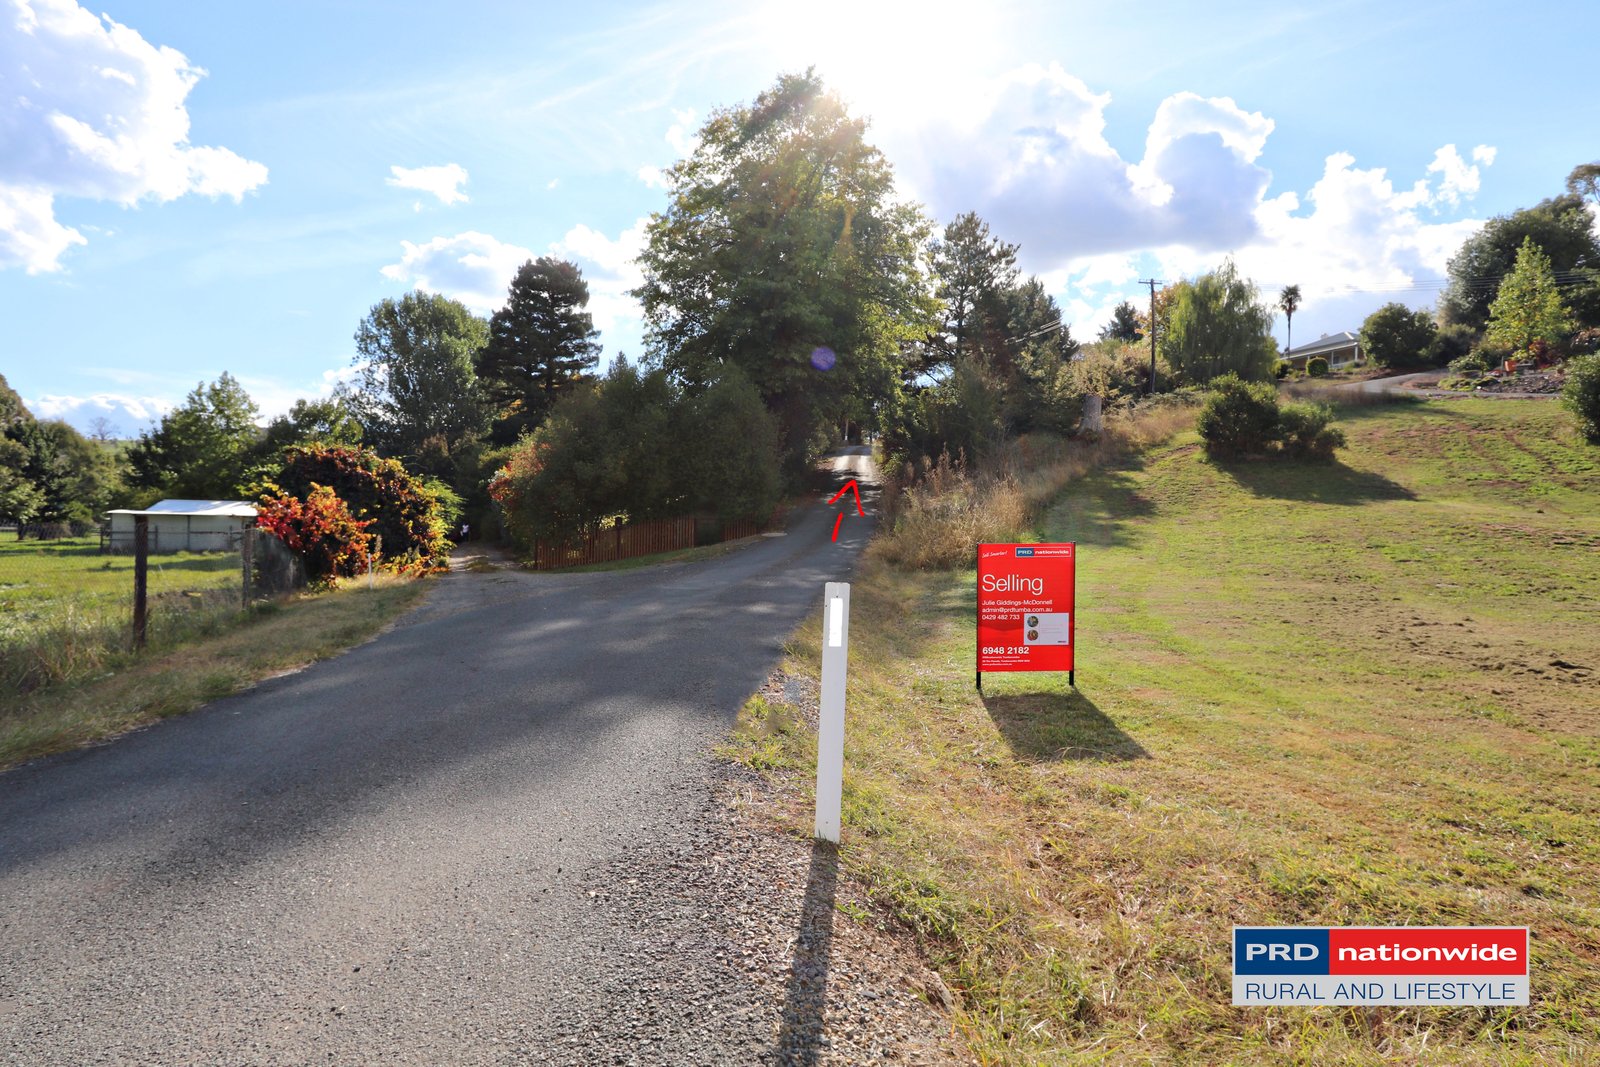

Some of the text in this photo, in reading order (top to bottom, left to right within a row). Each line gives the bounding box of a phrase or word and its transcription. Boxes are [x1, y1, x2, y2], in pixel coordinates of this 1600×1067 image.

[982, 574, 1043, 595] Selling
[996, 599, 1053, 607] Giddings-McDonnell
[982, 646, 1030, 655] 6948 2182
